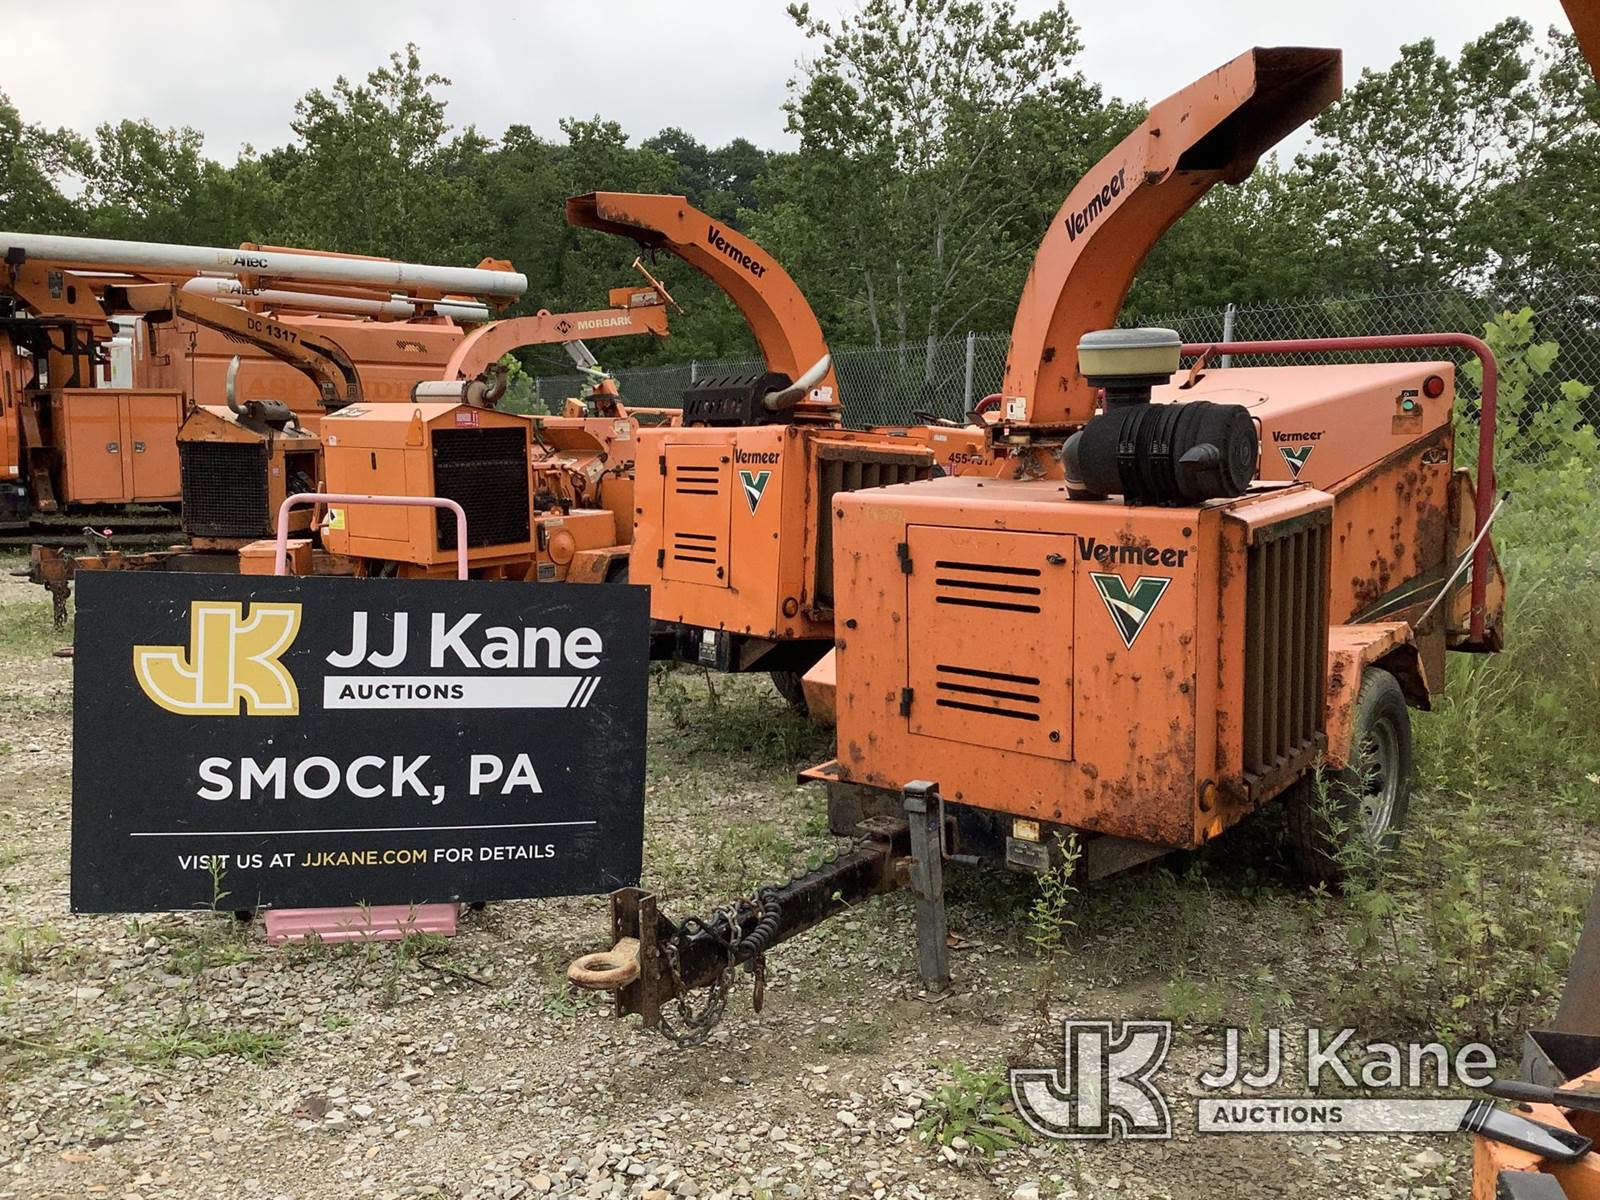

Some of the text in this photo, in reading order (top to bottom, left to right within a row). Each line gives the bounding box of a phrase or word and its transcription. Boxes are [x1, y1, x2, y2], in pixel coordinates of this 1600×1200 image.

[1064, 168, 1125, 242] Vermeer
[708, 224, 766, 278] Vermeer
[247, 317, 297, 343] DC 1317
[577, 316, 632, 330] MORBARK
[1272, 431, 1322, 442] Vermeer
[735, 448, 780, 464] Vermeer
[1078, 537, 1188, 567] Vermeer
[325, 611, 603, 670] JJ Kane
[338, 684, 464, 700] AUCTIONS
[196, 753, 543, 806] SMOCK, PA
[177, 843, 555, 870] VISIT US AT JJKANE.COM FOR DETAILS
